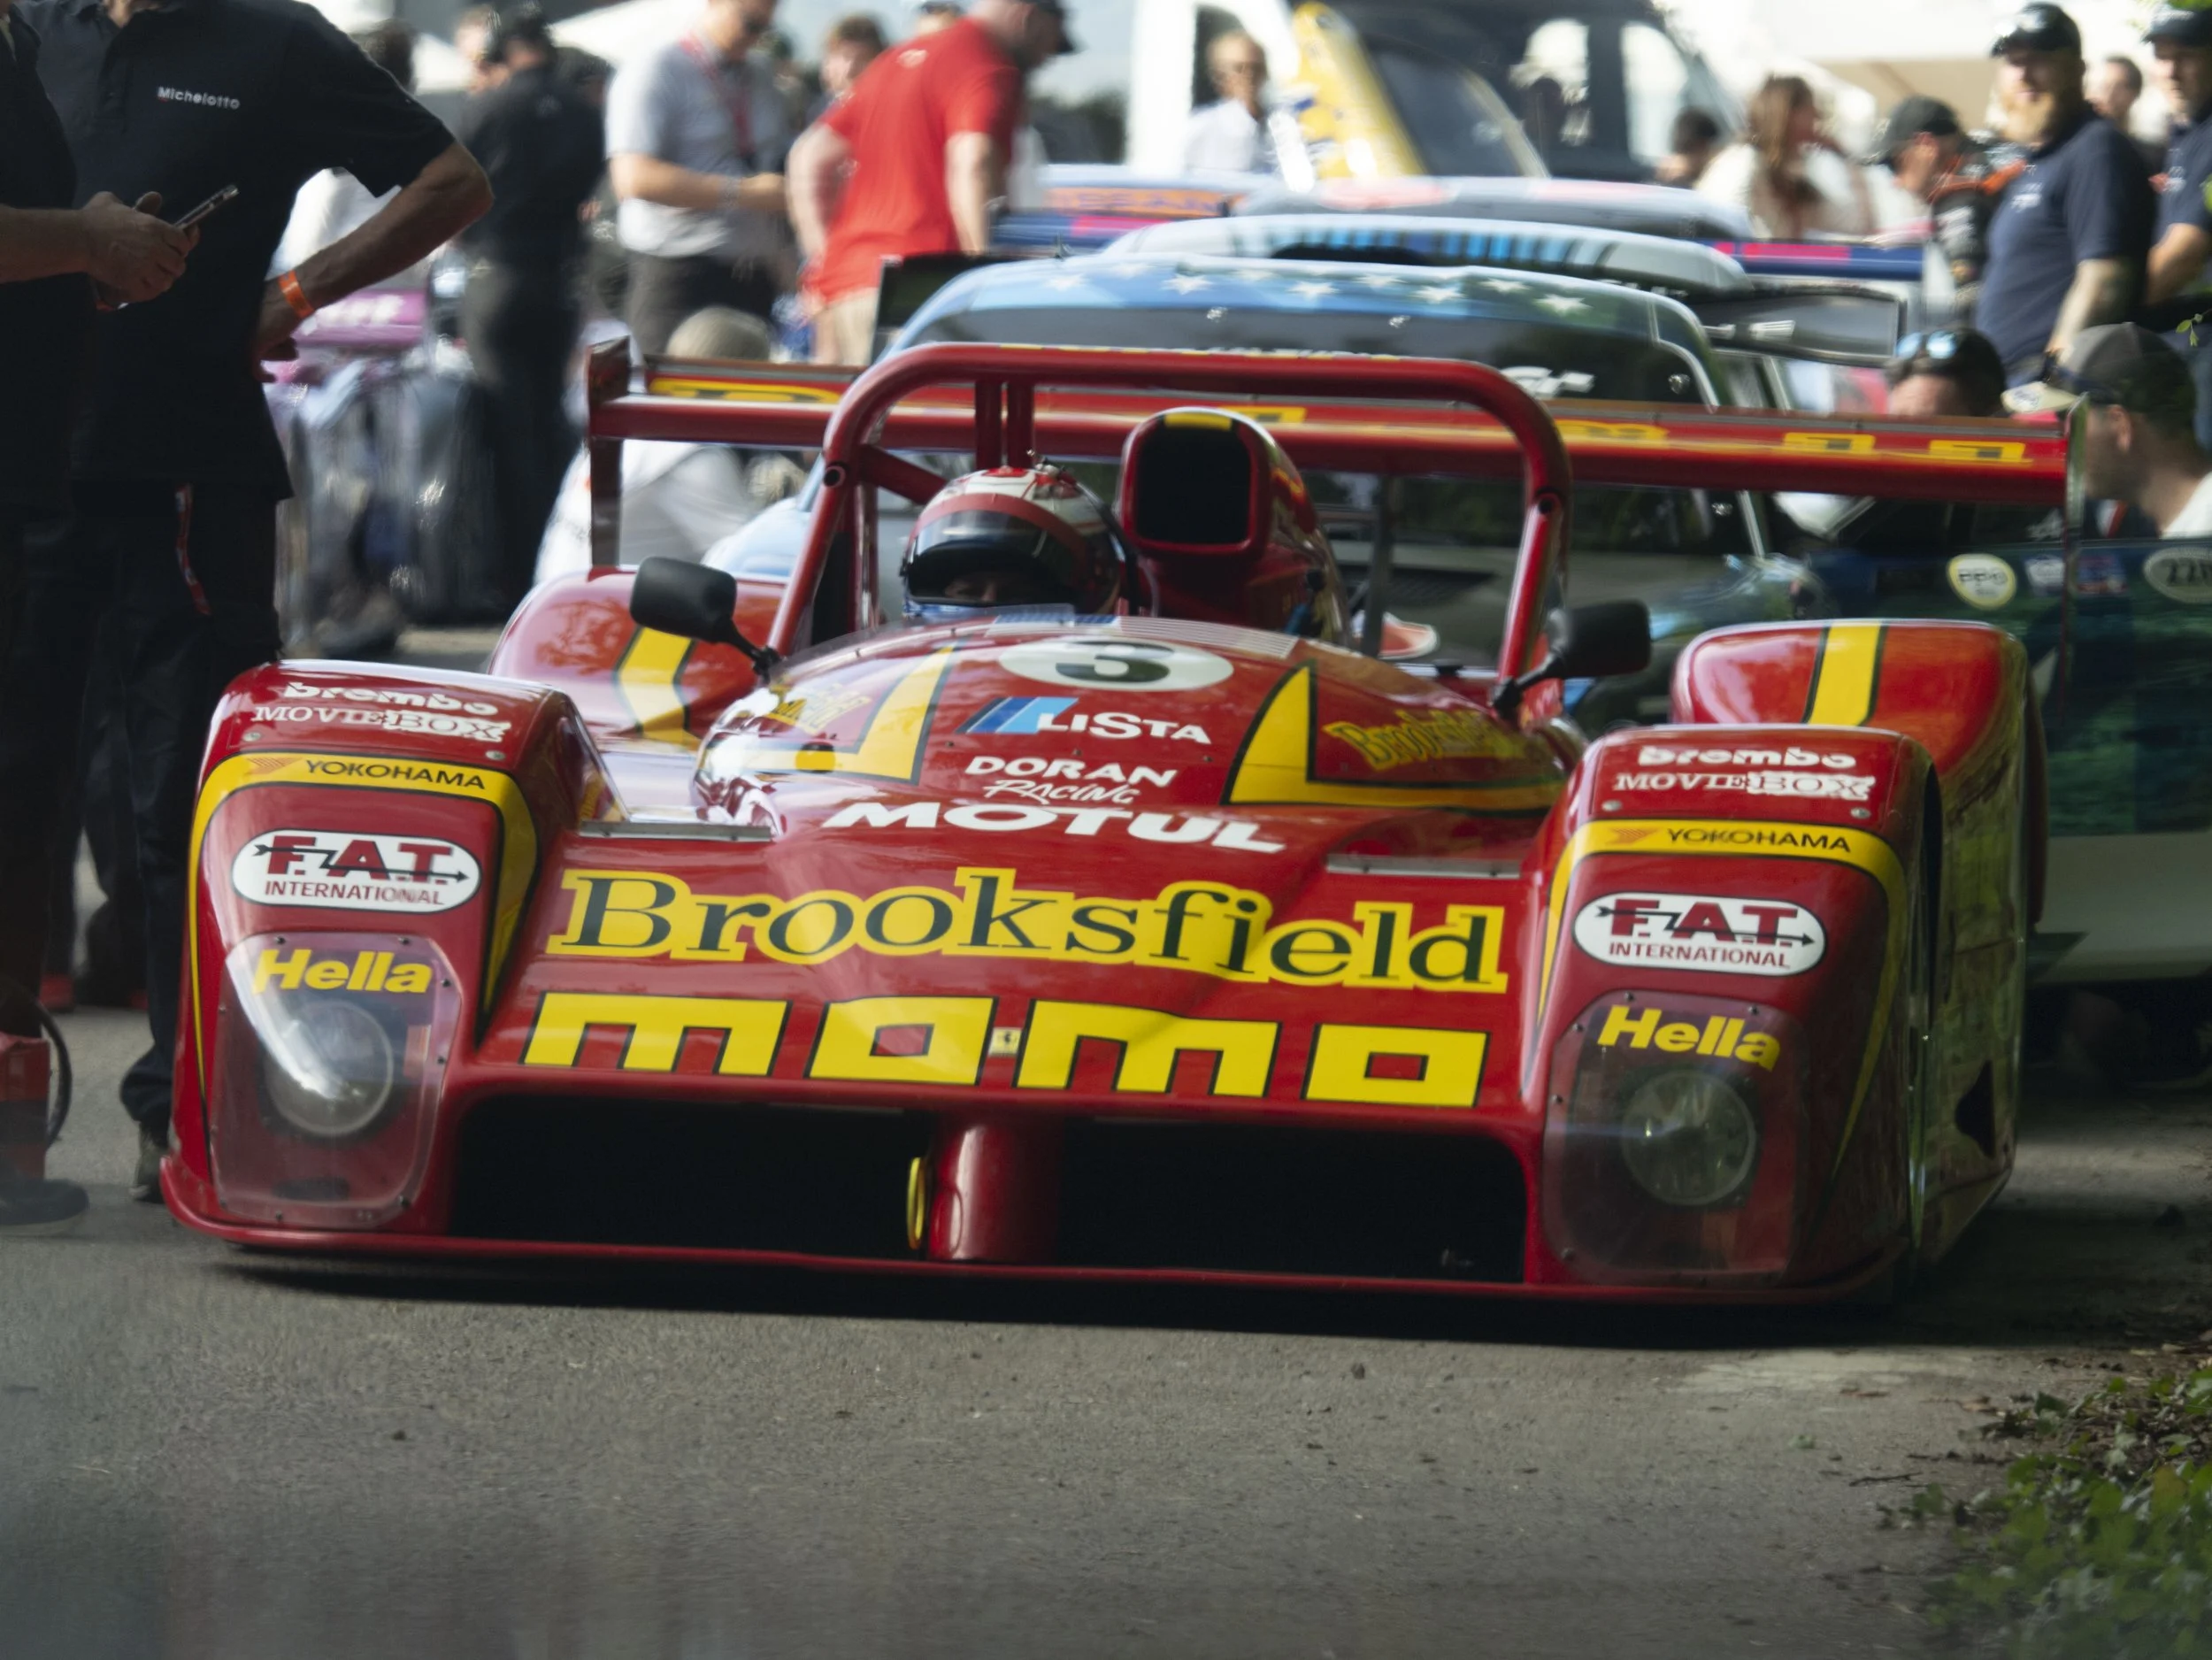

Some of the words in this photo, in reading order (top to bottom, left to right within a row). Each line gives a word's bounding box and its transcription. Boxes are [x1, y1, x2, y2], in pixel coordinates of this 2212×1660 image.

[157, 87, 240, 110] Michelotto
[1056, 641, 1175, 684] 3
[284, 682, 499, 715] brembo
[1036, 712, 1212, 744] LISTA
[964, 756, 1178, 788] DORAN
[1638, 747, 1856, 769] brembo
[305, 759, 486, 790] YOKOHAMA
[821, 802, 1286, 854] MOTUL
[1666, 828, 1851, 852] YOKOHAMA
[265, 880, 445, 905] INTERNATIONAL
[546, 867, 1508, 994] Brooksfield
[252, 949, 433, 995] Hella
[1609, 942, 1791, 970] INTERNATIONAL
[519, 990, 1491, 1108] momo
[1597, 1005, 1780, 1072] Hella
